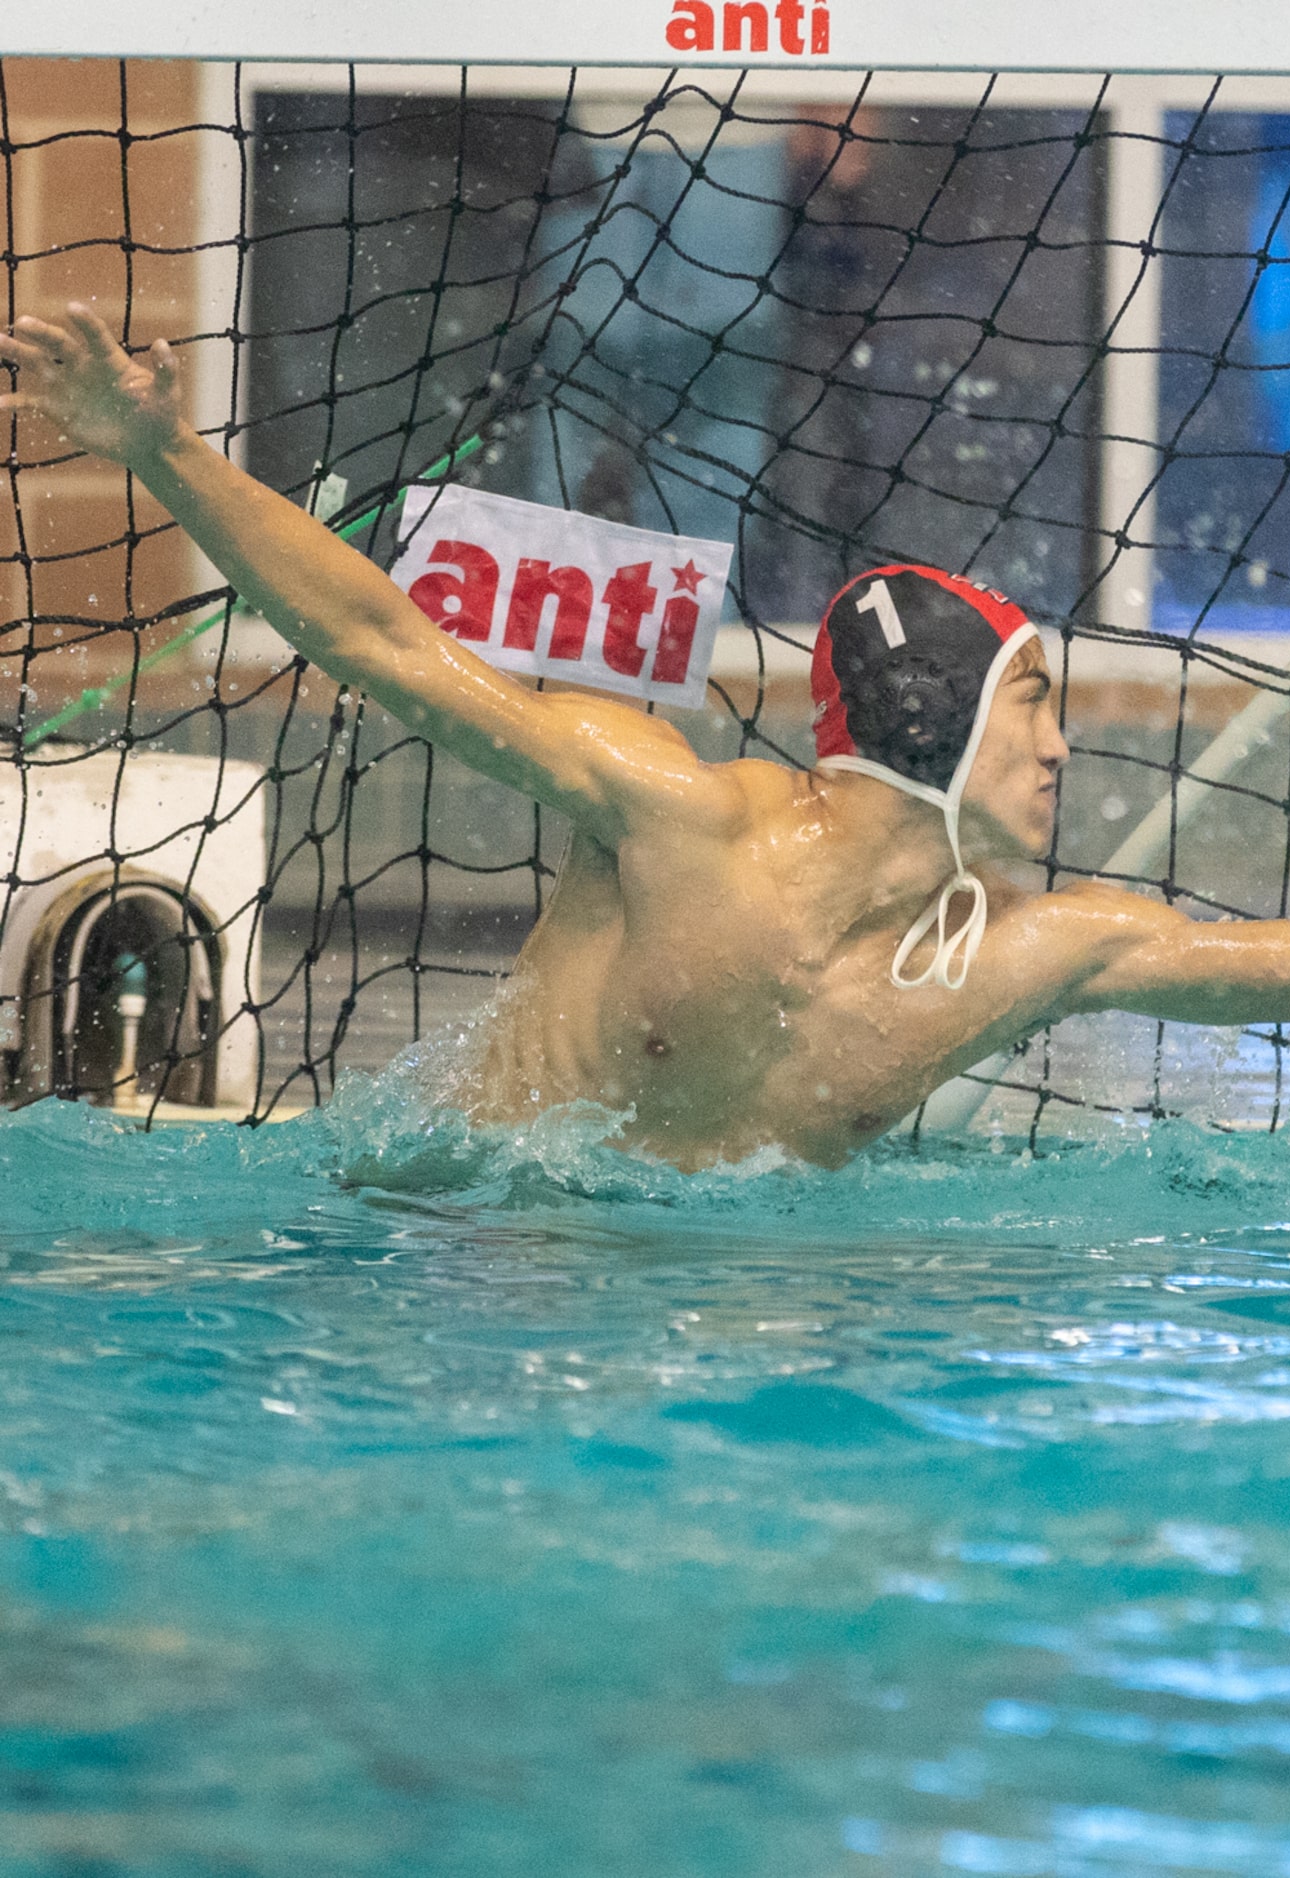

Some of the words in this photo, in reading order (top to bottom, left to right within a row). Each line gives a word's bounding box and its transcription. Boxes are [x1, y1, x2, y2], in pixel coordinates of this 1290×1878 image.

[665, 0, 830, 55] anti
[408, 539, 707, 684] anti
[855, 578, 906, 649] 1
